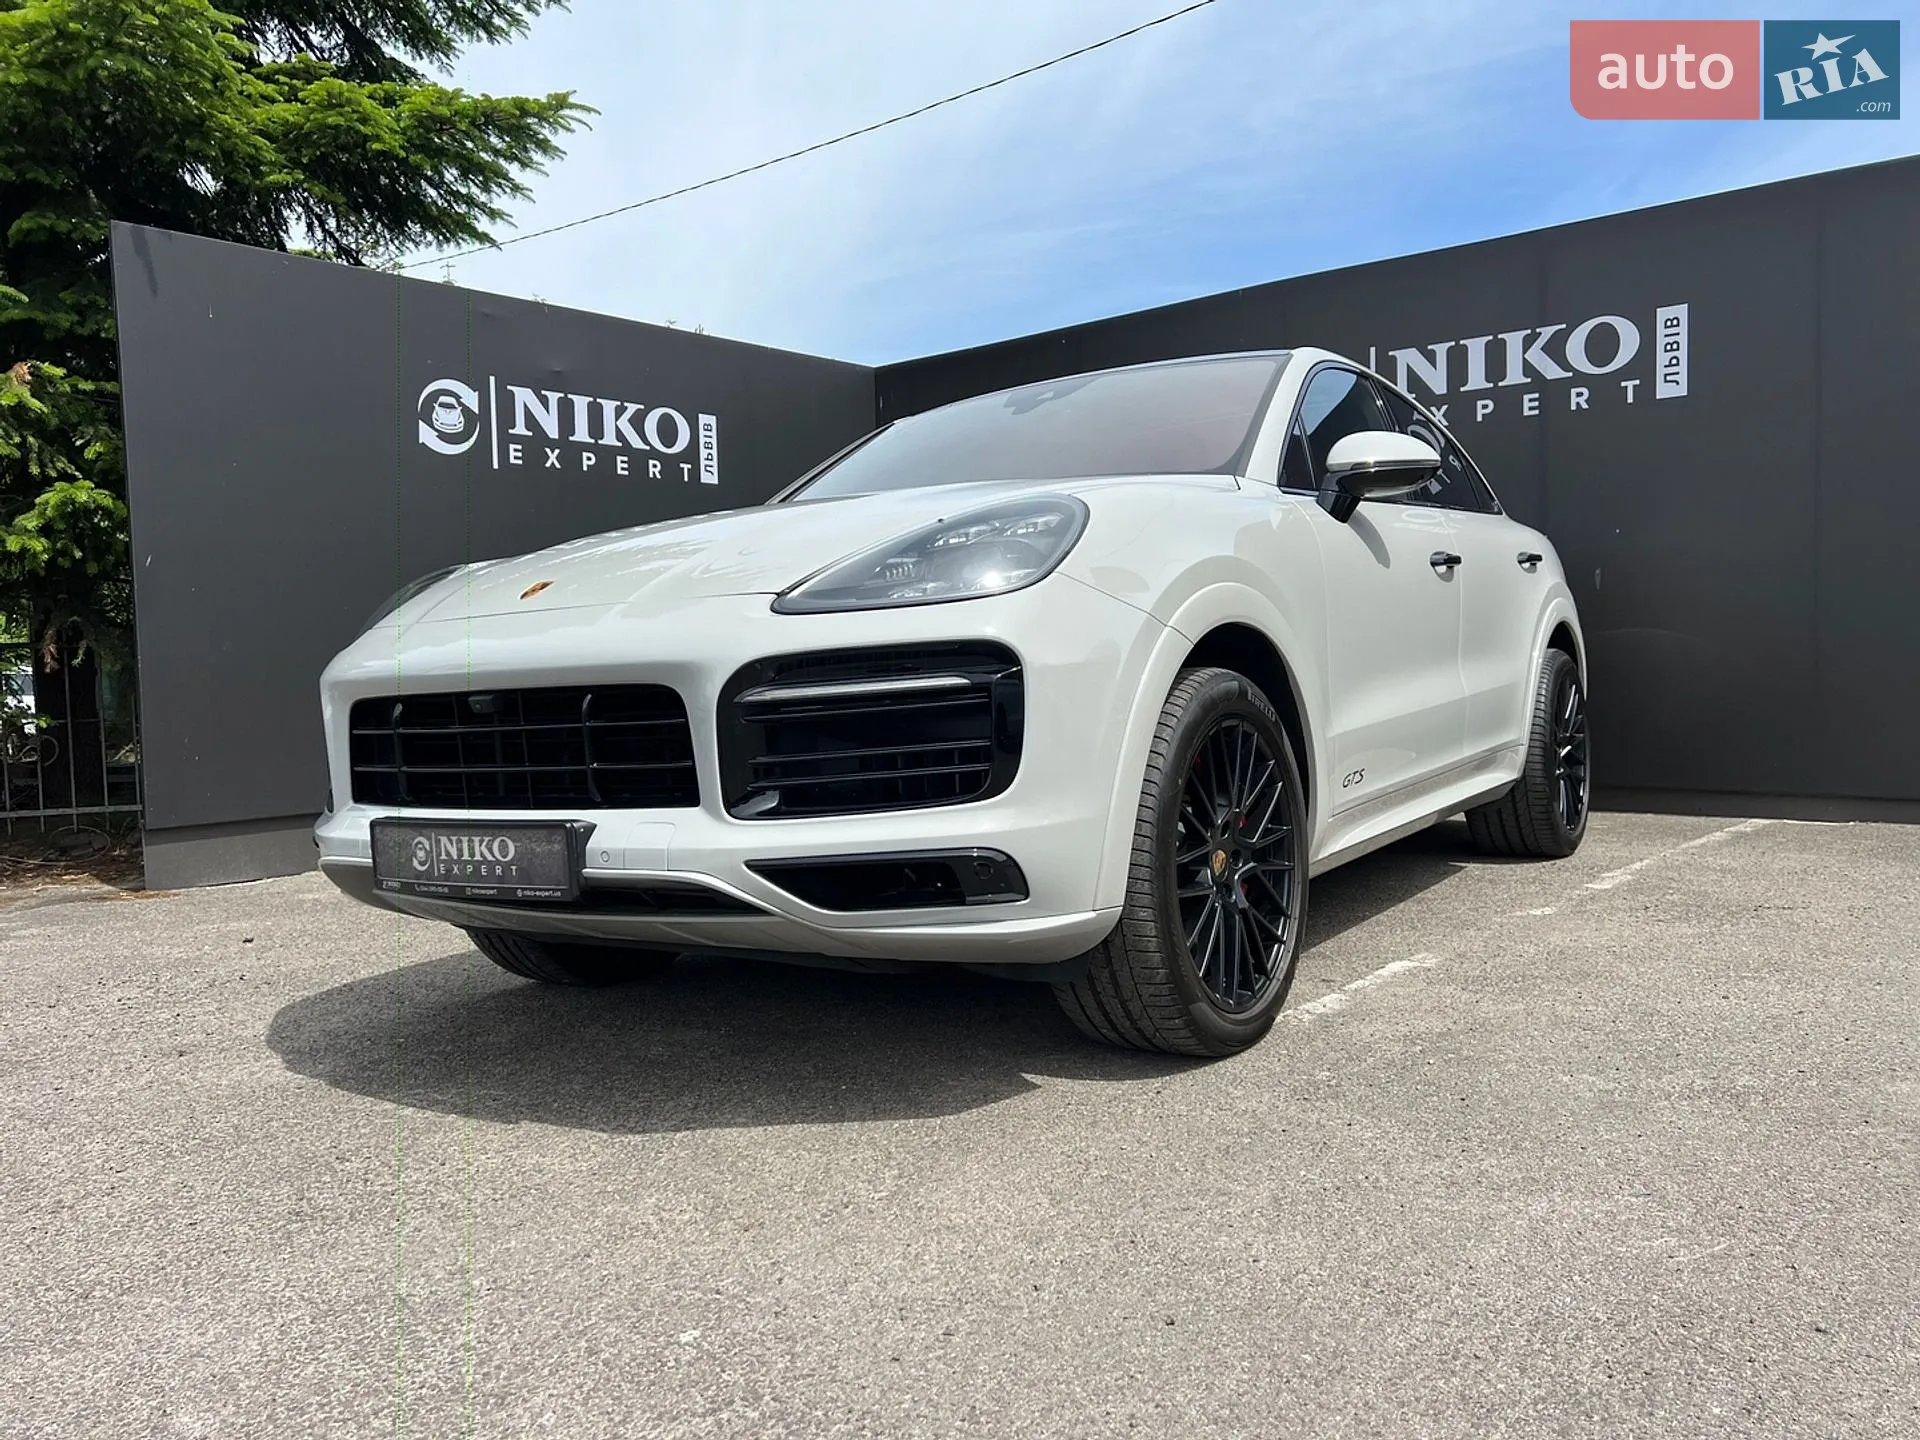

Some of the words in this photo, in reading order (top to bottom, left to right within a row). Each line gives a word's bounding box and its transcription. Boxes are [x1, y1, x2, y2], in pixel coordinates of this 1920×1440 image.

[1388, 315, 1640, 398] NIKO
[1663, 315, 1681, 386] ЛЬВІВ
[506, 385, 691, 454] NIKO
[1429, 379, 1640, 426] XPERT
[508, 443, 692, 482] EXPERT
[703, 421, 716, 476] ЛЬВІВ
[1343, 768, 1365, 788] GTS
[438, 835, 516, 862] NIKO
[439, 864, 518, 876] EXPERT
